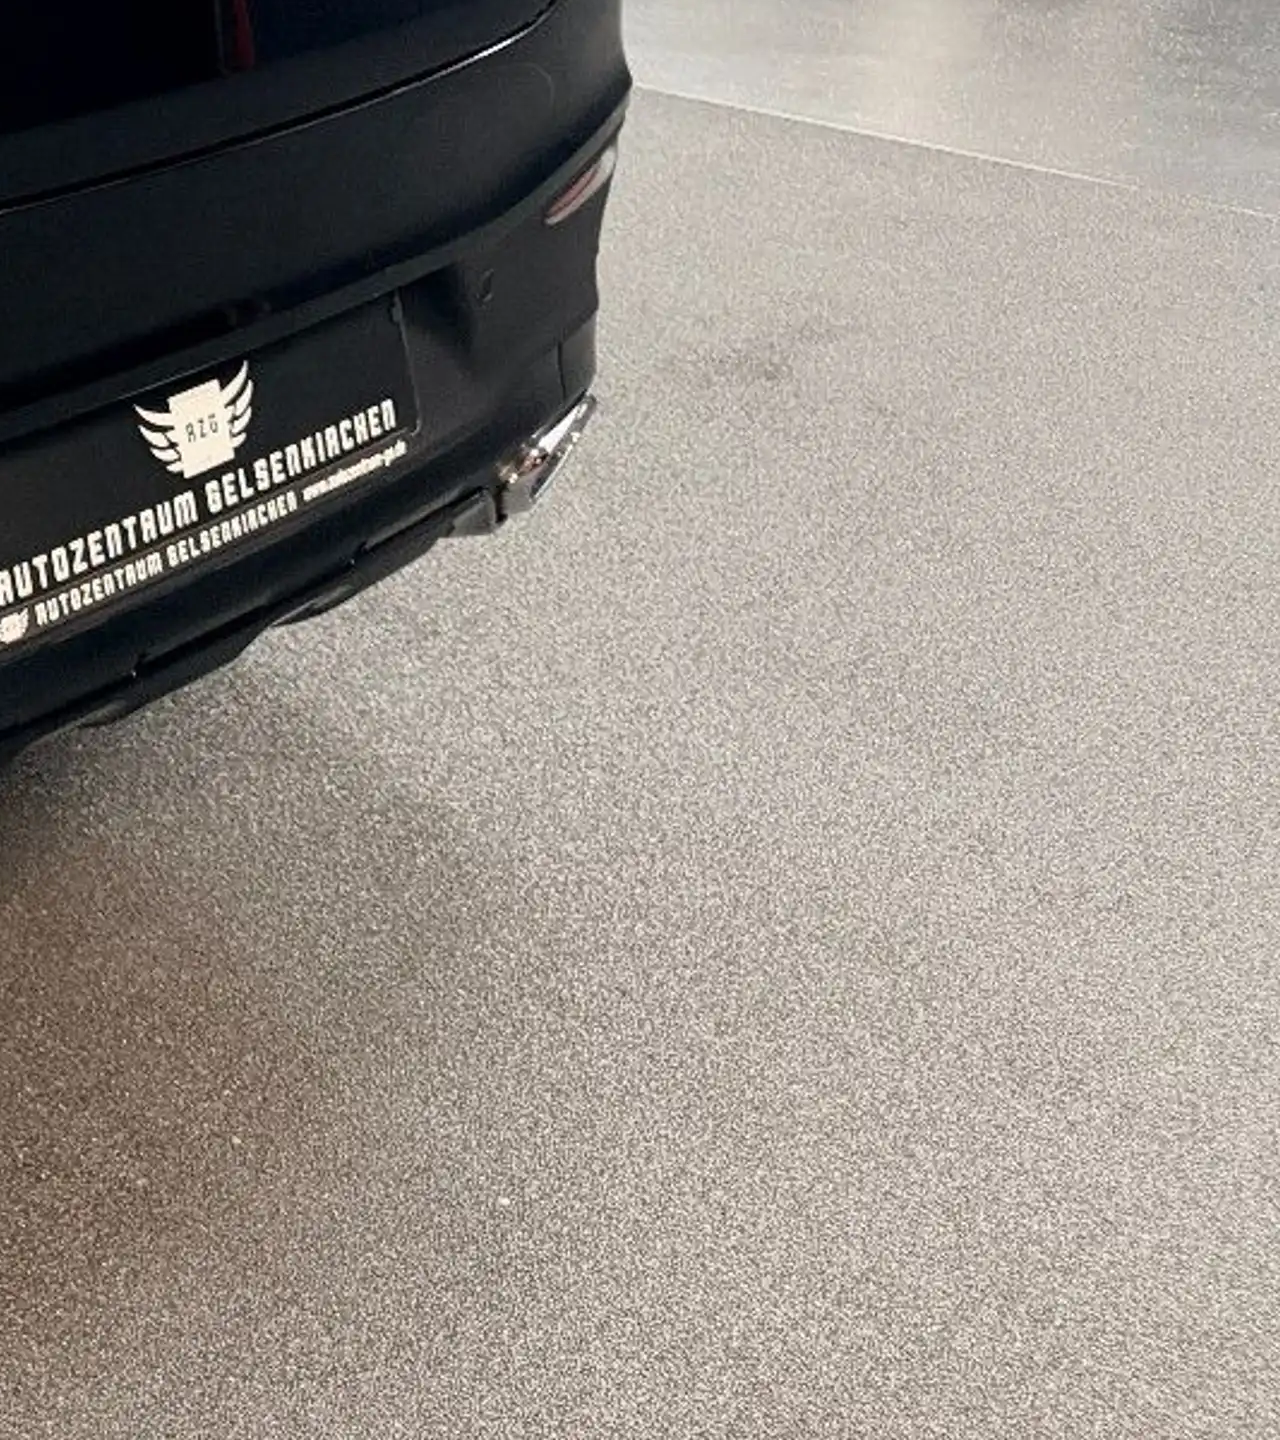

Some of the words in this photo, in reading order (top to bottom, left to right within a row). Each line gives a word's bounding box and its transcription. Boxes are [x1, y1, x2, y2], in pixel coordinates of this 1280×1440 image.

[185, 413, 218, 442] AZG
[204, 399, 396, 514] GELSENKIRCHEN
[34, 552, 163, 626] AUTOZENTRUM
[166, 491, 298, 568] GELSENKIRCHEN
